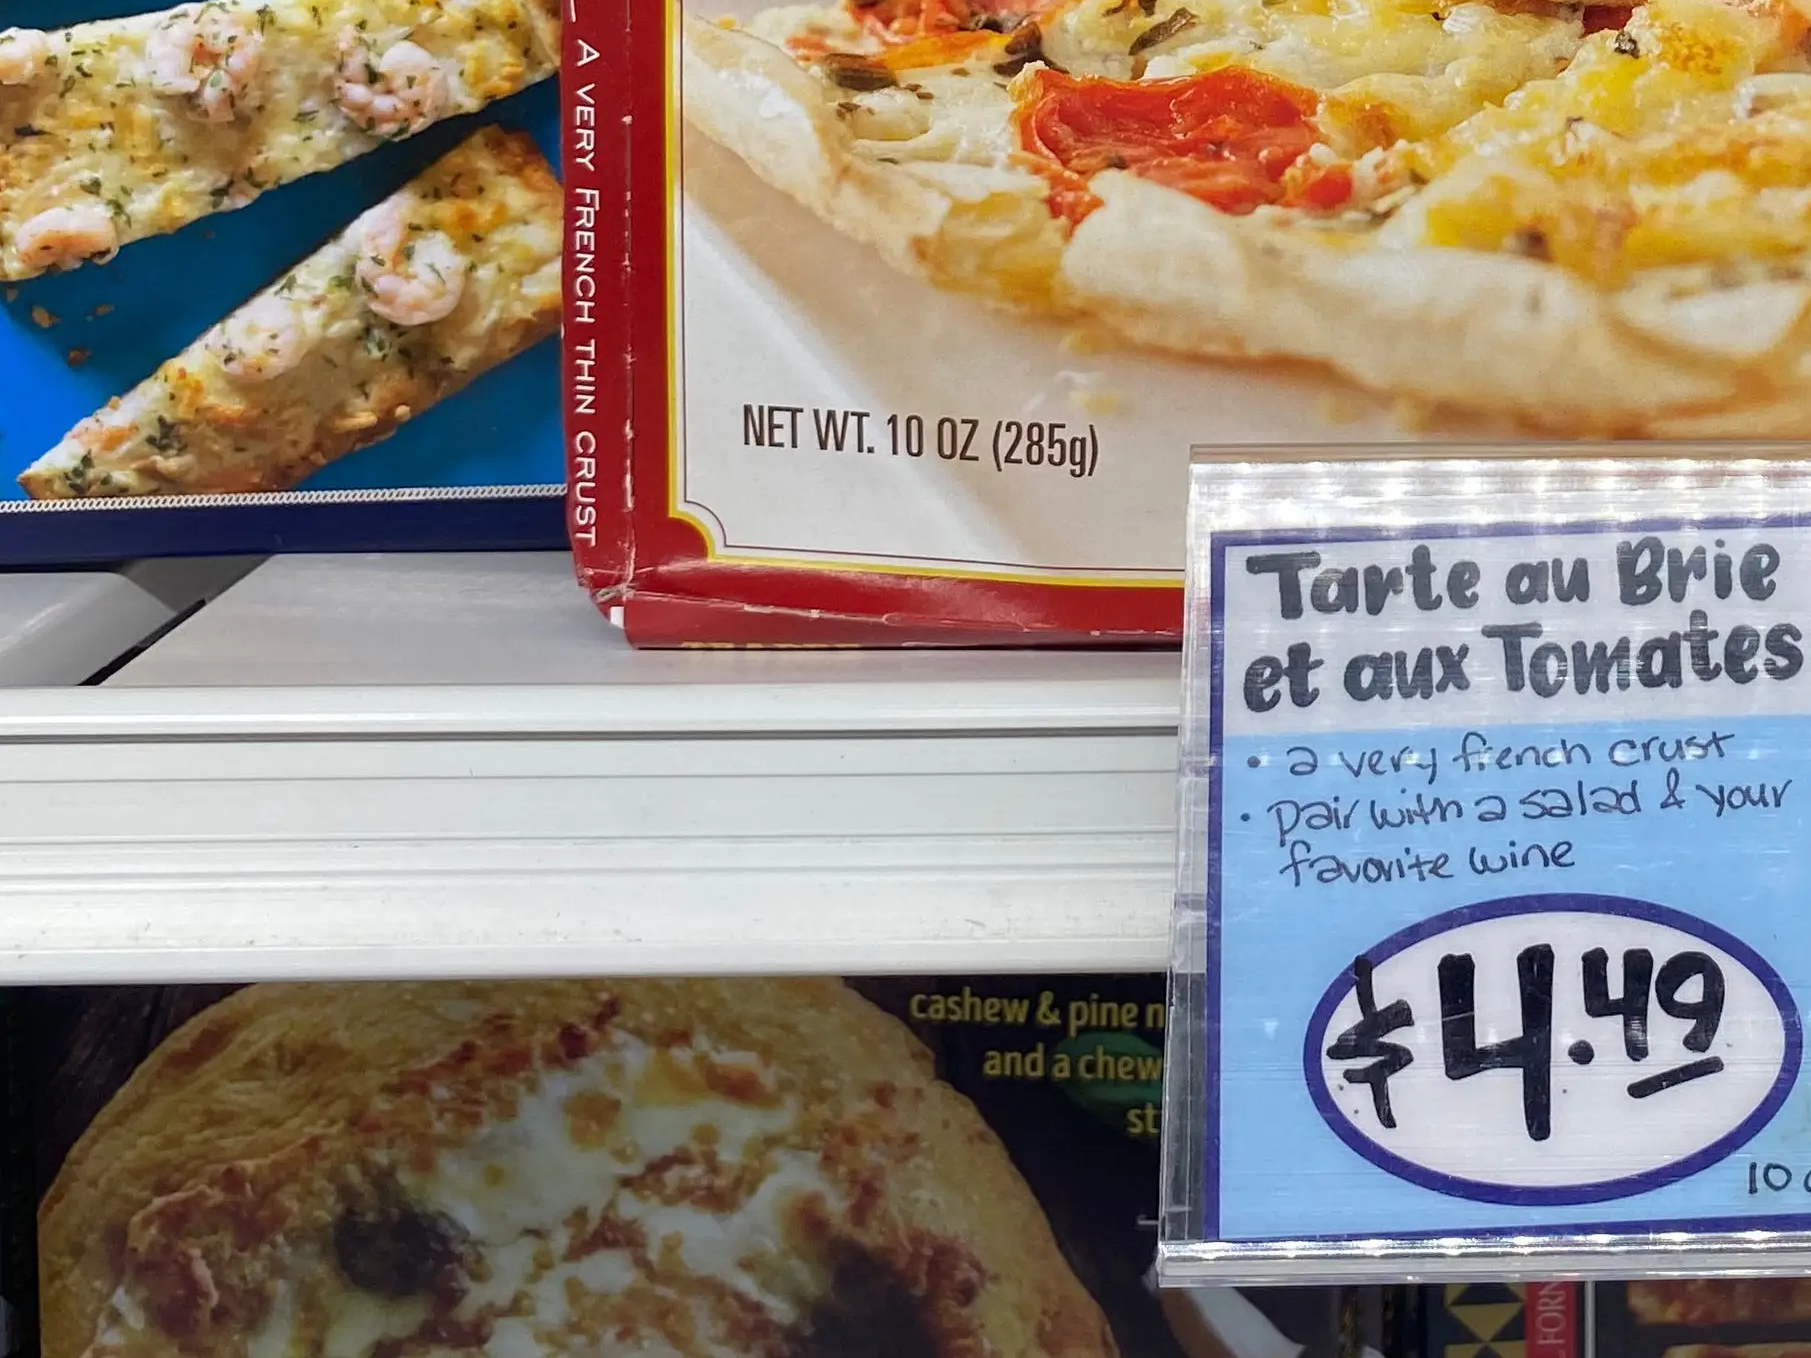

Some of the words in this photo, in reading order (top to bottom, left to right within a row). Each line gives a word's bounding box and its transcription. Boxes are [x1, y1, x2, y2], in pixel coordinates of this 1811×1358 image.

[577, 39, 601, 66] A
[573, 84, 598, 170] VERY
[572, 189, 600, 325] FRENCH
[574, 338, 597, 415] THIN
[743, 403, 804, 449] NET
[812, 408, 876, 455] WT.
[886, 413, 924, 458] 10
[936, 416, 980, 462] OZ
[992, 419, 1099, 478] (285g)
[573, 431, 597, 546] CRUST
[1245, 542, 1481, 620] Tarte
[1504, 556, 1590, 607] au
[1615, 535, 1781, 607] Brie
[1243, 641, 1325, 713] et
[1343, 640, 1471, 702] aux
[1481, 609, 1805, 699] Tomates
[1287, 747, 1319, 776] a
[1339, 742, 1437, 785] very
[1608, 732, 1735, 766] crust
[1267, 797, 1360, 846] pair
[1369, 788, 1465, 830] with
[1474, 794, 1508, 822] a
[1518, 778, 1642, 819] salad
[1659, 767, 1686, 810] &
[1694, 777, 1794, 818] your
[1278, 839, 1455, 887] favorite
[1468, 838, 1577, 875] wine
[909, 986, 1031, 1023] cashew
[1036, 991, 1062, 1026] &
[1069, 993, 1139, 1037] pine
[1326, 942, 1728, 1142] $4.49
[983, 1042, 1046, 1079] and
[1052, 1053, 1071, 1079] a
[1747, 1160, 1792, 1196] 10
